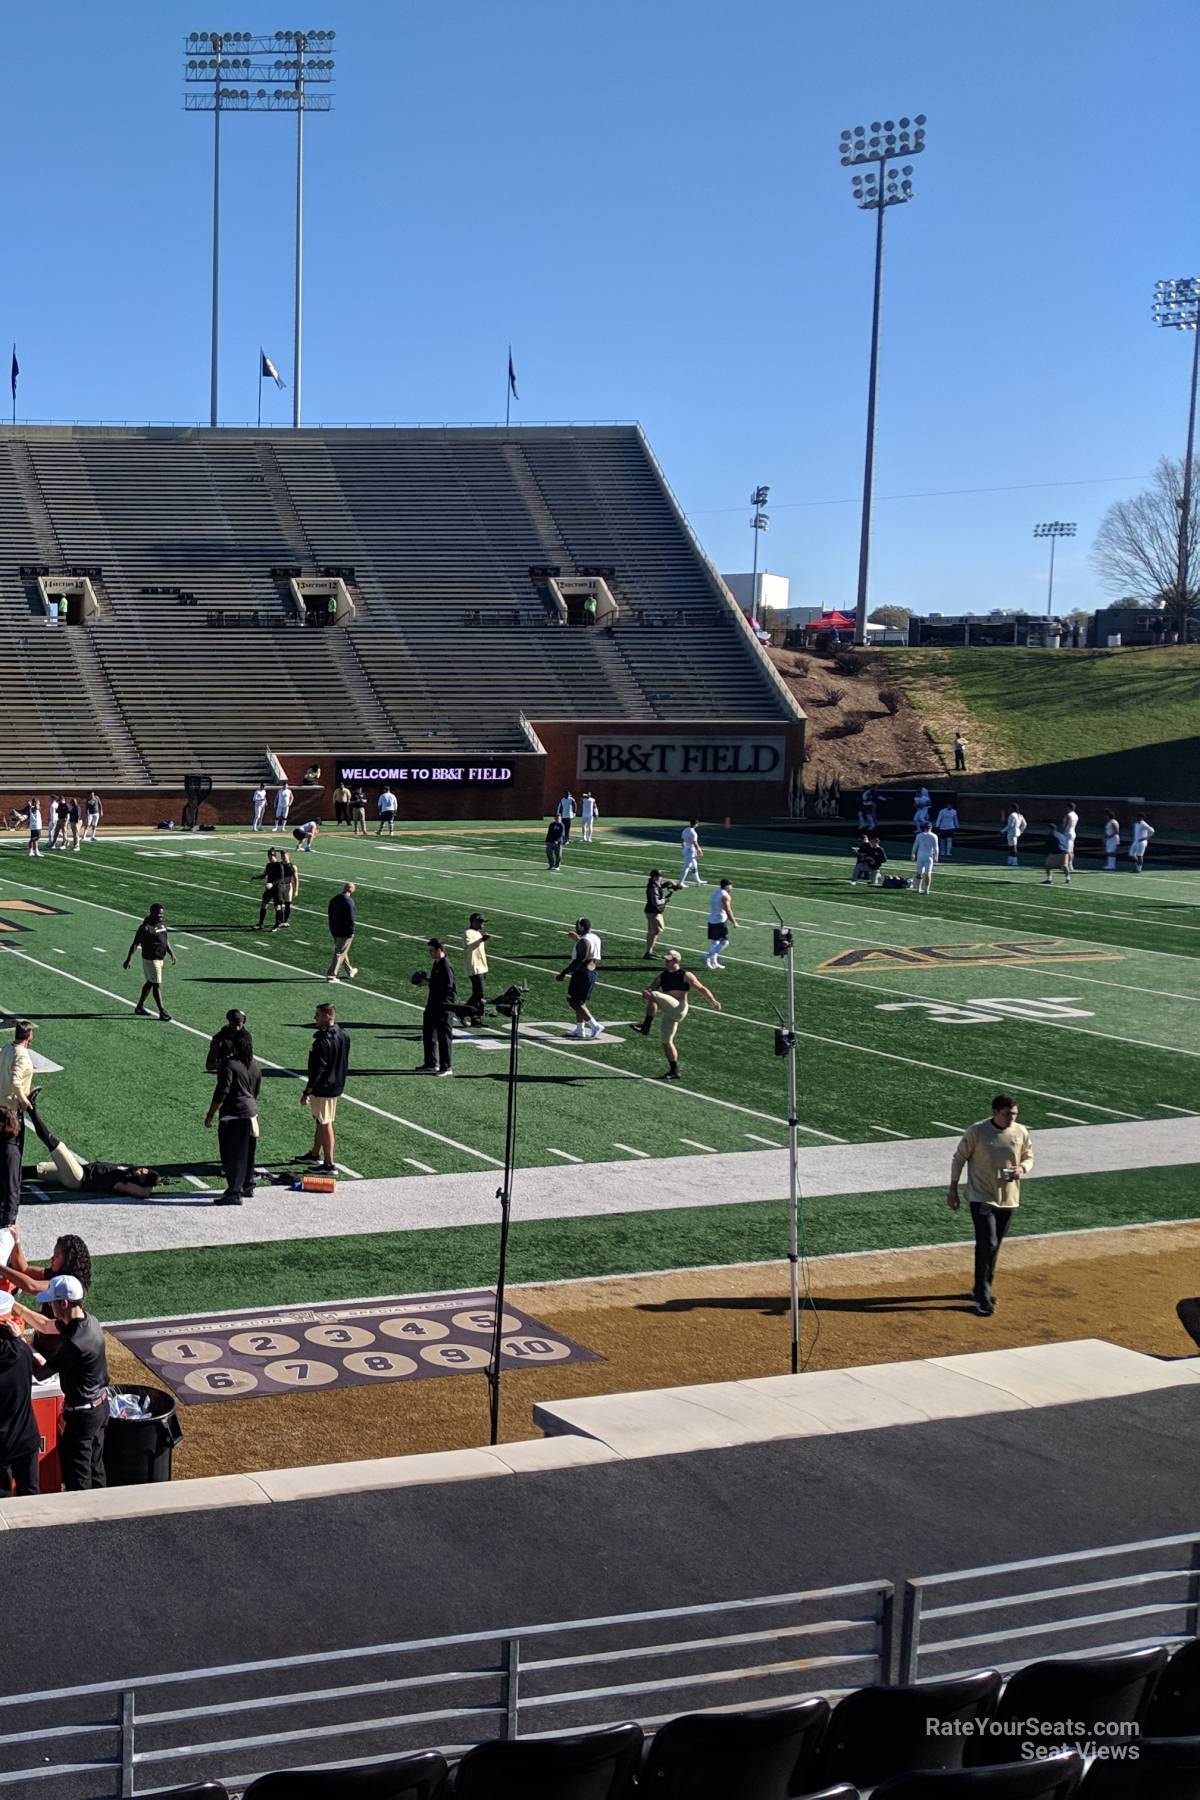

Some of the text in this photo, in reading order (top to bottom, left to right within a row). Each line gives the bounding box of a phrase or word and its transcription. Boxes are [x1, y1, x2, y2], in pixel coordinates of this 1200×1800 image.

[583, 743, 781, 773] BB&T FIELD
[341, 768, 512, 780] WELCOME TO BB&T FIELD
[815, 940, 1127, 973] ACC
[874, 997, 1096, 1024] 30
[348, 1301, 464, 1316] SPECIAL TEAMS
[401, 1321, 427, 1335] 4
[469, 1314, 497, 1328] 5
[250, 1336, 278, 1351] 2
[324, 1329, 353, 1343] 3
[176, 1344, 198, 1359] 1
[504, 1339, 555, 1356] 10
[363, 1355, 395, 1371] 8
[439, 1348, 471, 1363] 9
[284, 1362, 310, 1380] 7
[205, 1372, 236, 1389] 6
